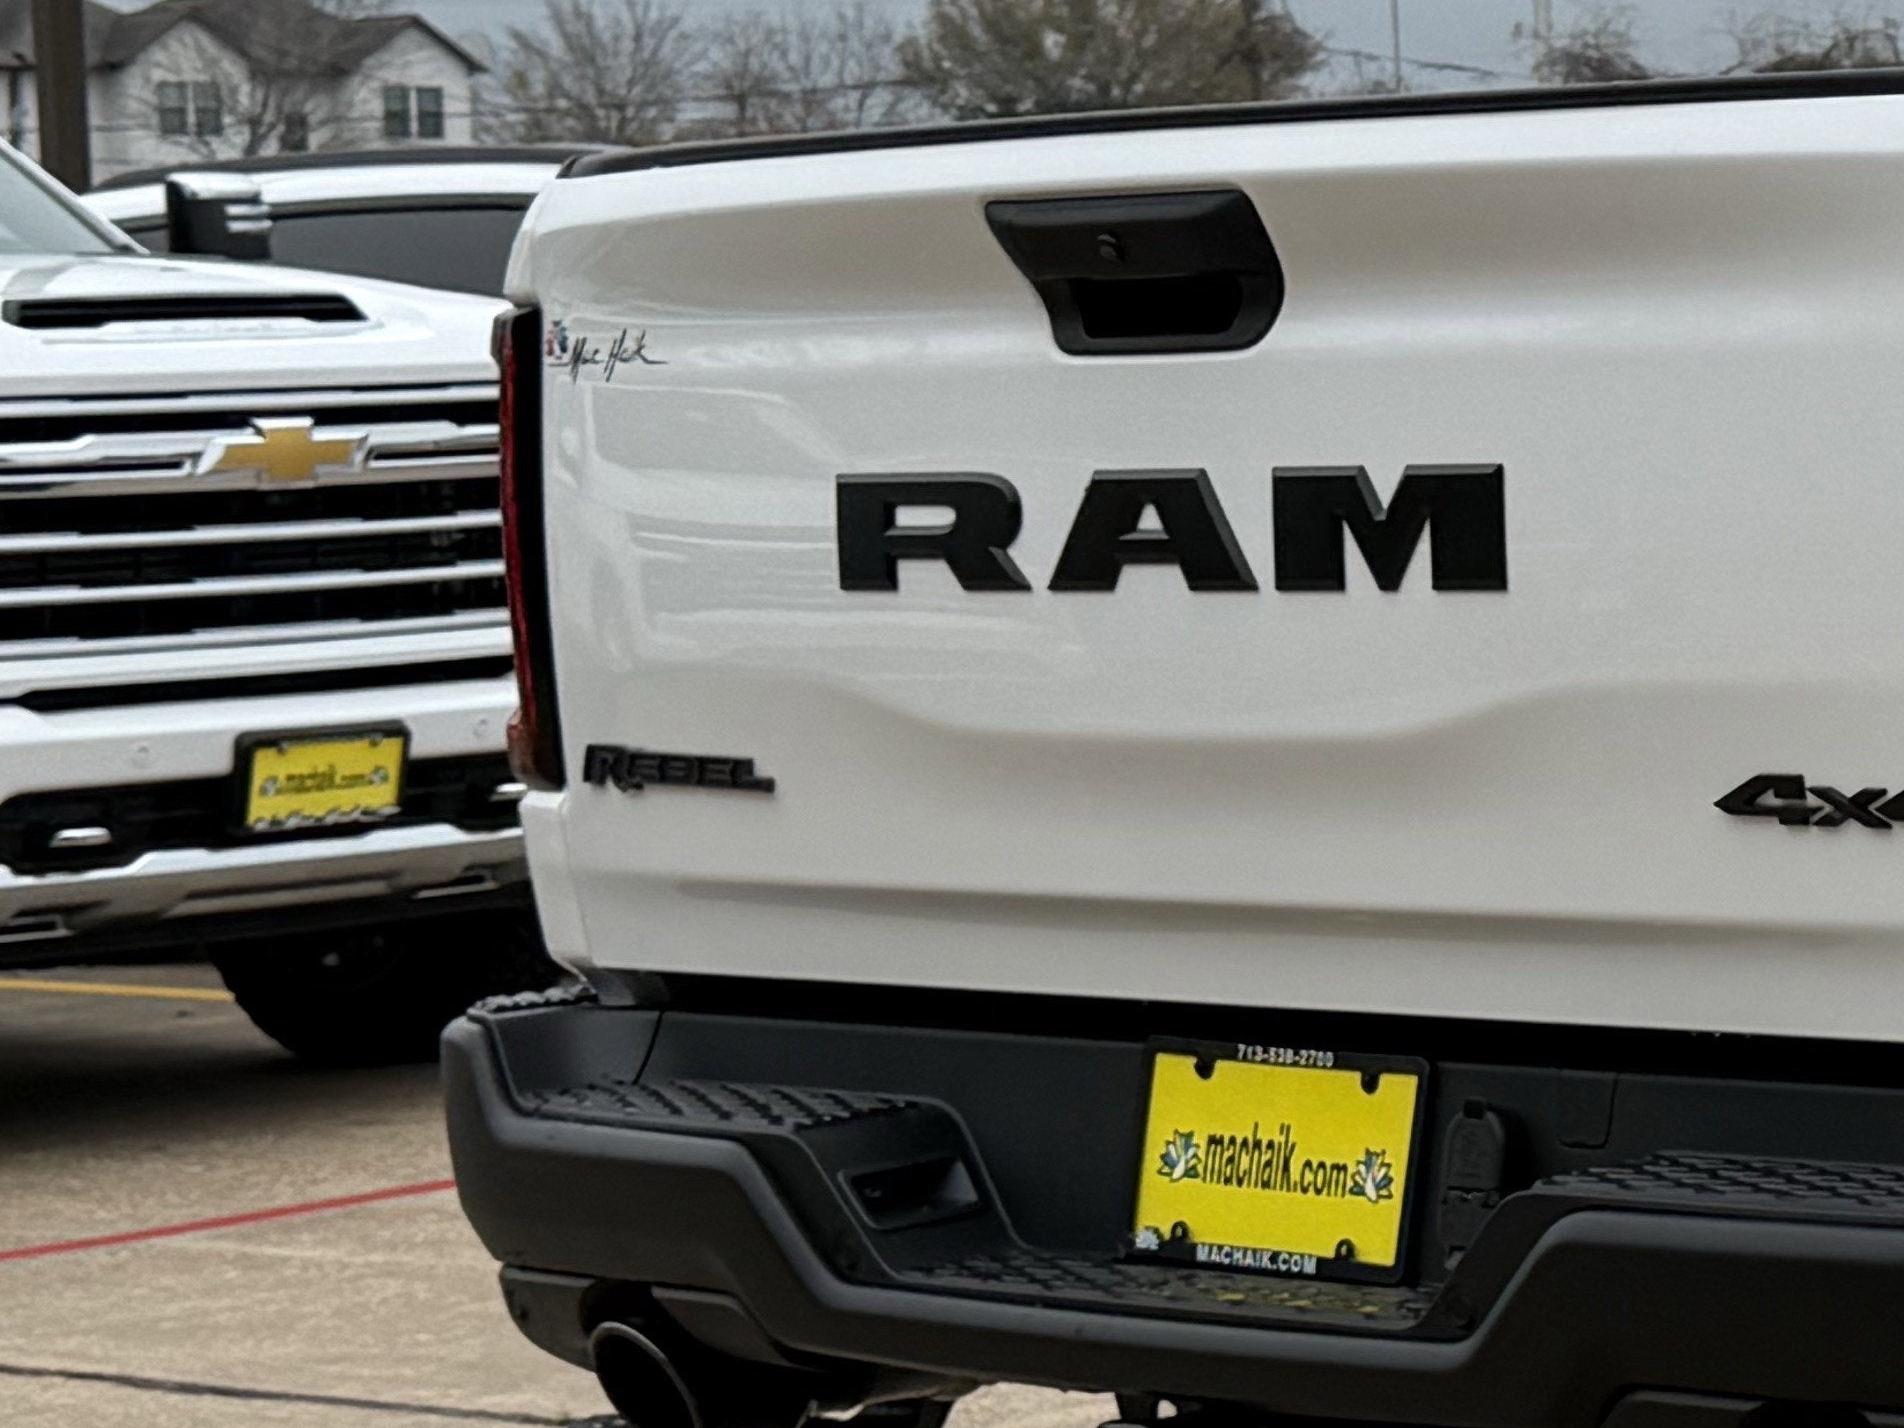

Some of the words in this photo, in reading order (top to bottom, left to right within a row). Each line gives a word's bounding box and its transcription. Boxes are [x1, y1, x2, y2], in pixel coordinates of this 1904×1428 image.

[835, 463, 1508, 593] RAM
[583, 743, 775, 793] REBEL
[1201, 1121, 1350, 1198] machaik.com
[1196, 1244, 1317, 1275] MACHAIK.COM
